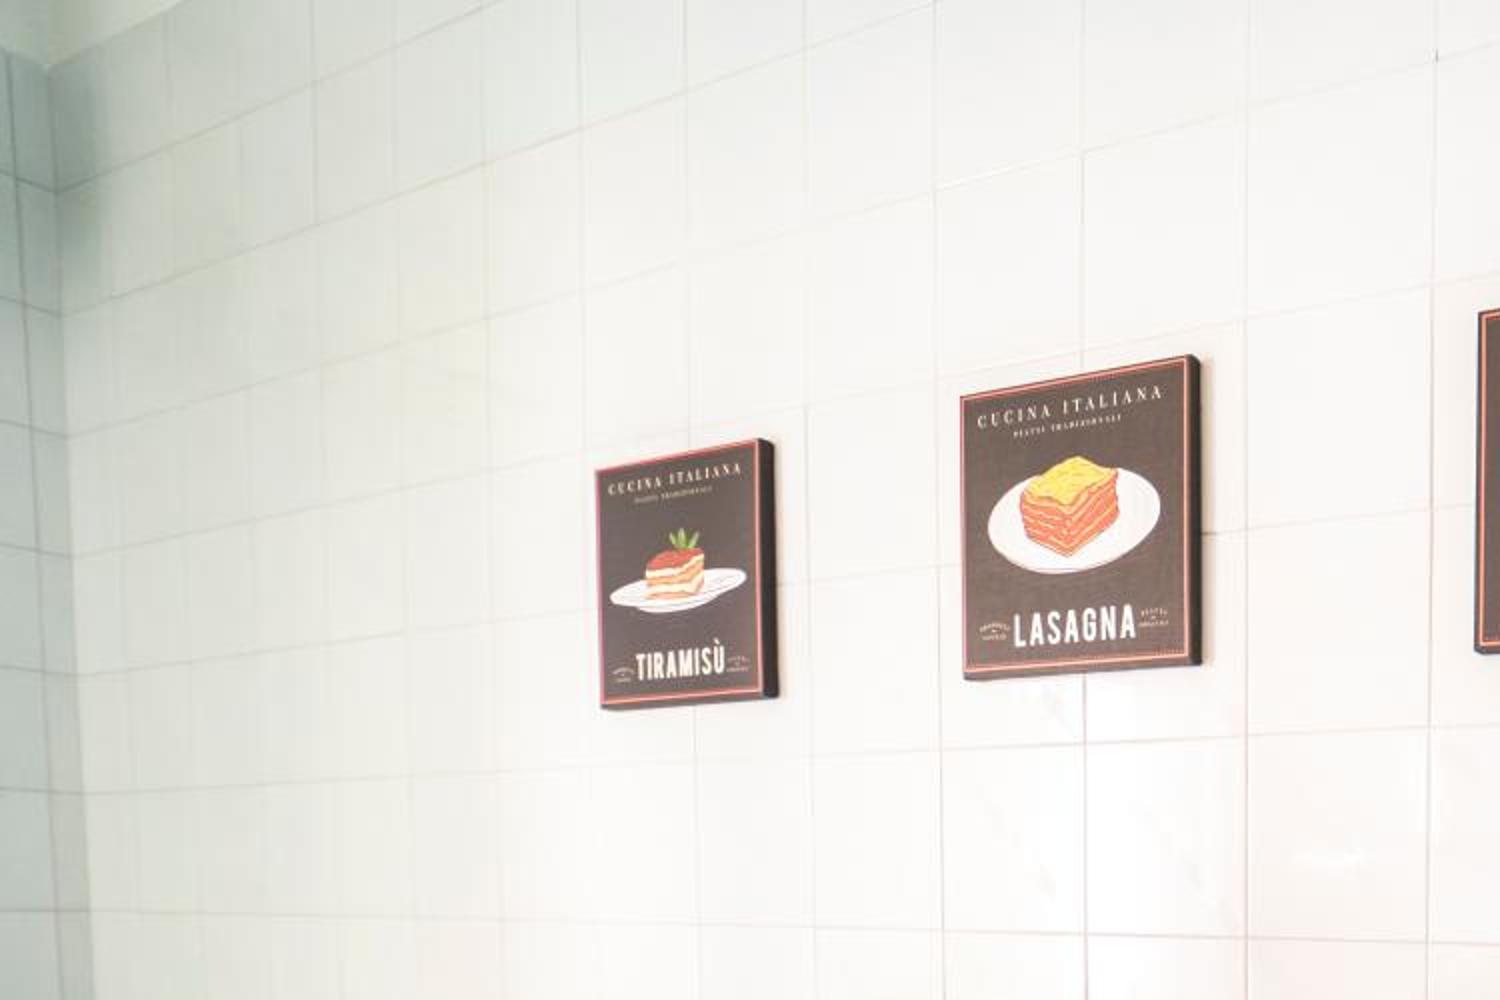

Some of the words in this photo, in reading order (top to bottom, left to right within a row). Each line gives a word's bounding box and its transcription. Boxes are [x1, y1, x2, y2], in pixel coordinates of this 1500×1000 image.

[977, 404, 1050, 429] CUCINA
[1062, 385, 1162, 415] ITALIANA
[607, 476, 661, 496] CUCINA
[669, 463, 741, 485] ITALIANA
[1013, 603, 1136, 648] LASAGNA
[635, 637, 725, 681] TIRAMISÙ
